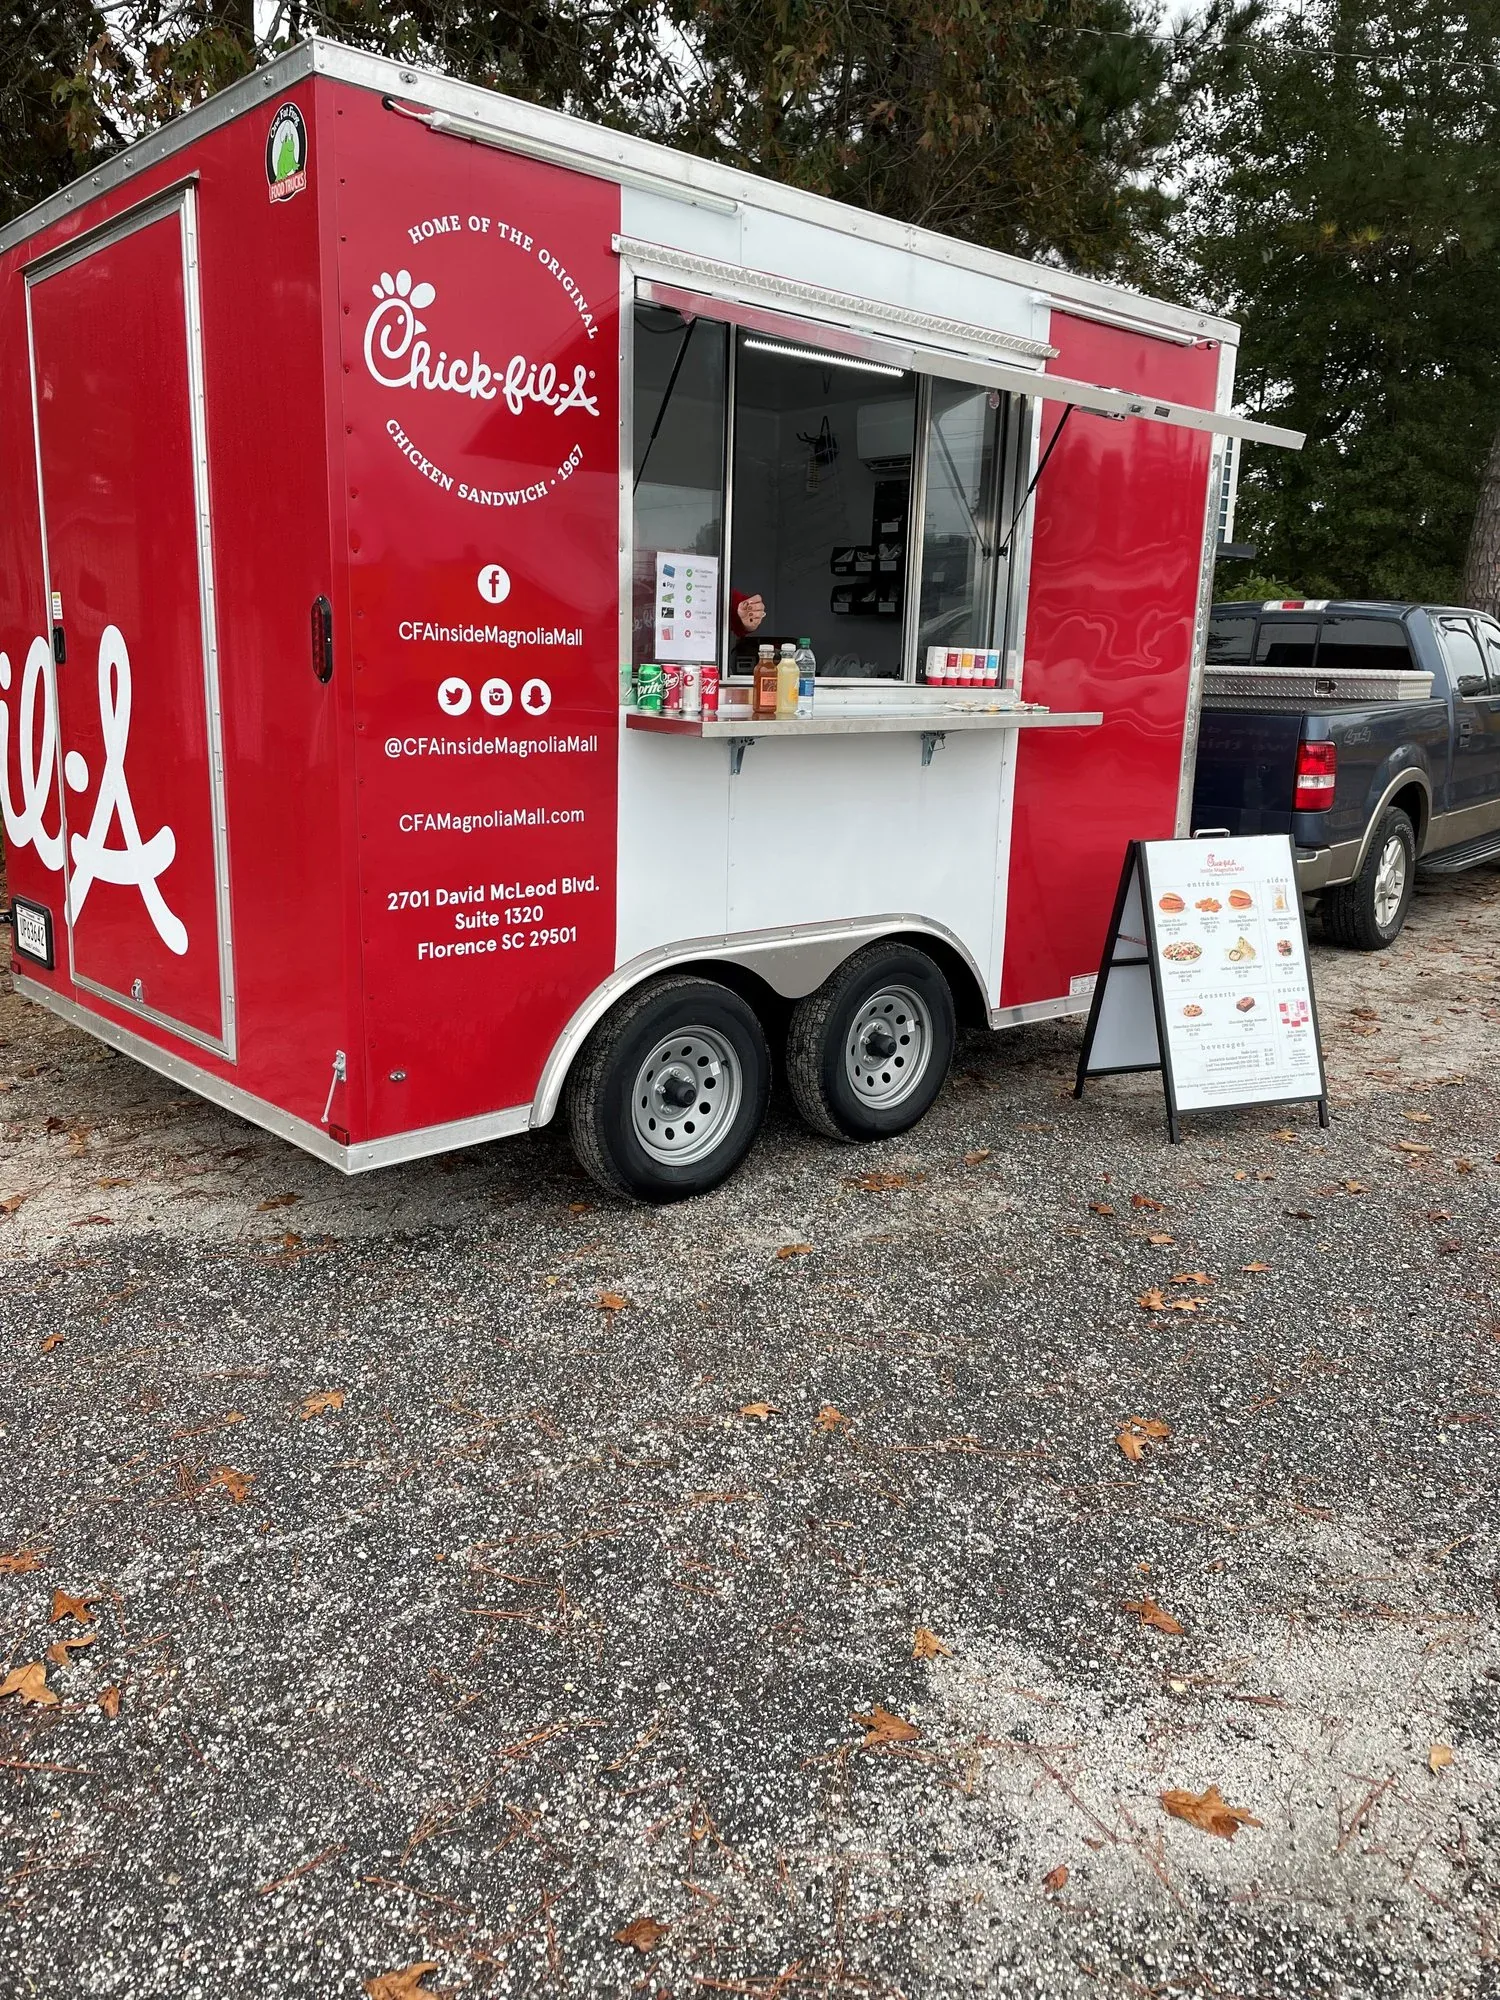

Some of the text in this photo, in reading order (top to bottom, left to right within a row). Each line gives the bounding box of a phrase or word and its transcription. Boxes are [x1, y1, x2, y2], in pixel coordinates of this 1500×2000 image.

[271, 173, 304, 199] FOOD TRUCKS
[408, 214, 599, 340] HOME OF THE ORIGINAL
[385, 418, 585, 507] CHICKEN SANDWICH 1967
[398, 620, 583, 649] CFAinsideMagnoliaMall
[384, 735, 598, 758] @CFAinsideMagnoliaMall
[399, 808, 585, 834] CFAMagnoliaMall.com
[387, 876, 600, 911] 2701 David McLeod Blvd.
[455, 905, 544, 931] Suite 1320
[418, 926, 577, 960] Florence SC 29501
[1198, 991, 1236, 1000] desserts
[1200, 1041, 1246, 1051] beverages
